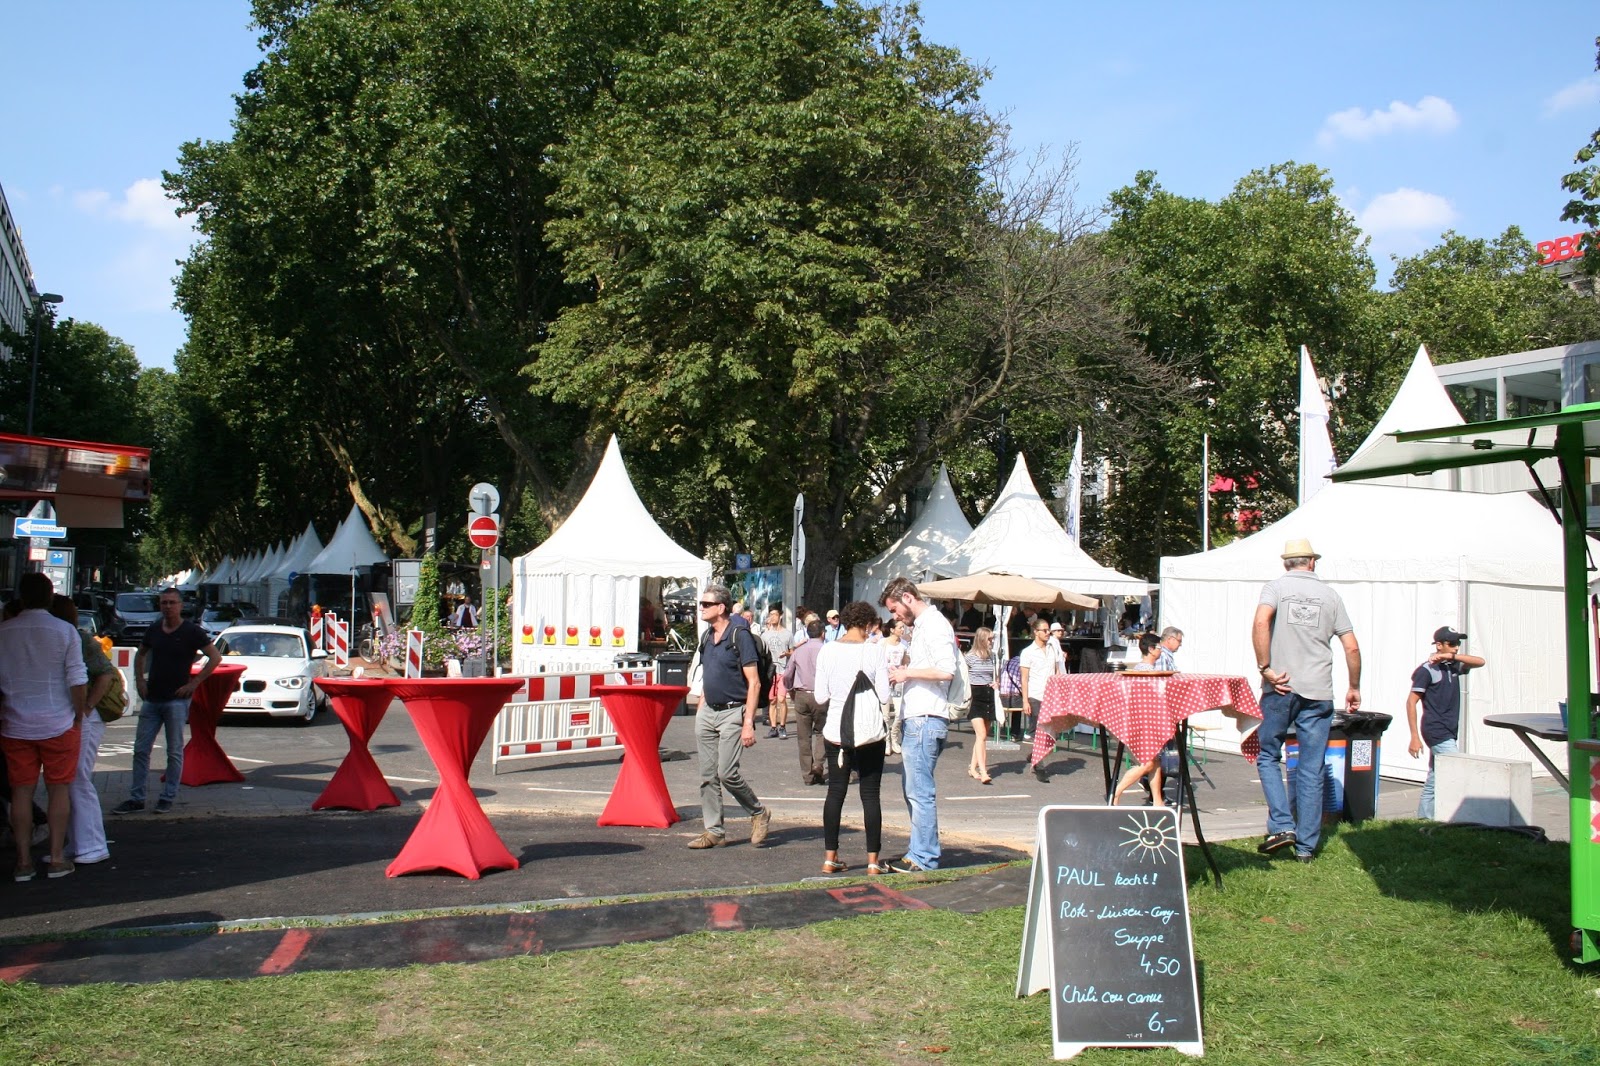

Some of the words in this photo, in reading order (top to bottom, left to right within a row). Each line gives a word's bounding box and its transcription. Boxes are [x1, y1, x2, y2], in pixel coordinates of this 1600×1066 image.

[1056, 866, 1106, 887] PAUL
[1114, 928, 1165, 951] Suppe
[1140, 953, 1181, 977] 4,50
[1062, 984, 1099, 1004] Chili
[1101, 991, 1124, 1004] con
